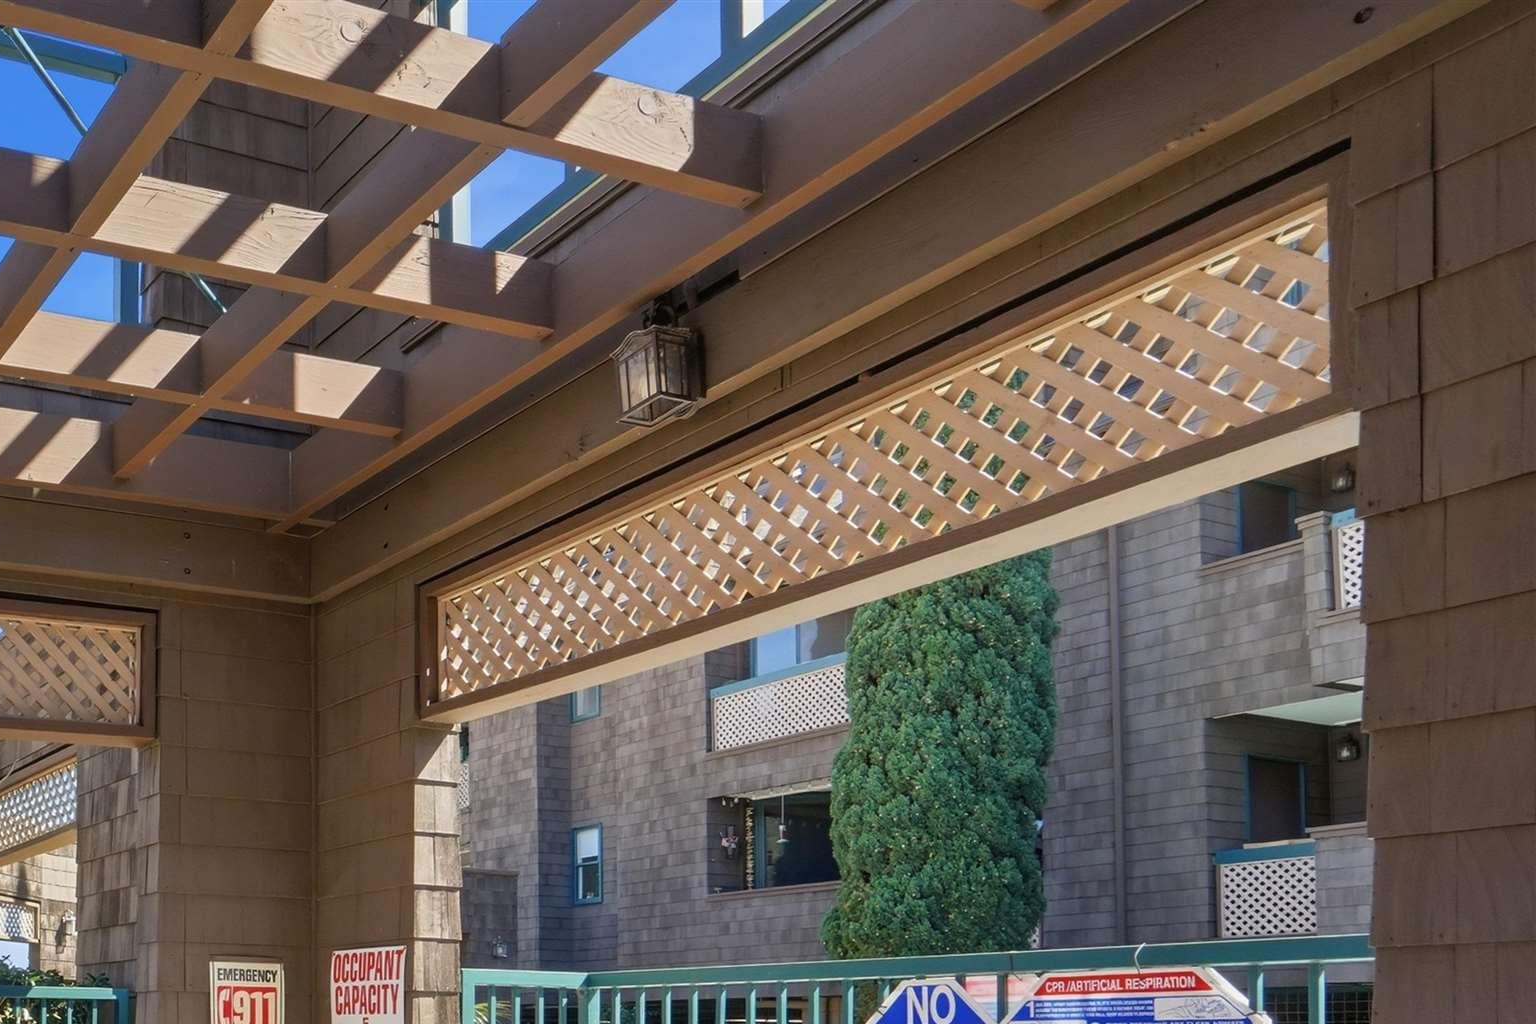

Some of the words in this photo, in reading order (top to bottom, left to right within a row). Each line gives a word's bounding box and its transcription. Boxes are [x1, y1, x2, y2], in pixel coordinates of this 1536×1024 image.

[333, 950, 403, 983] OCCUPANT
[217, 968, 277, 983] EMERGENCY
[1125, 975, 1196, 990] RESPIRATION
[335, 984, 399, 1015] CAPACITY
[1026, 1001, 1034, 1018] 1
